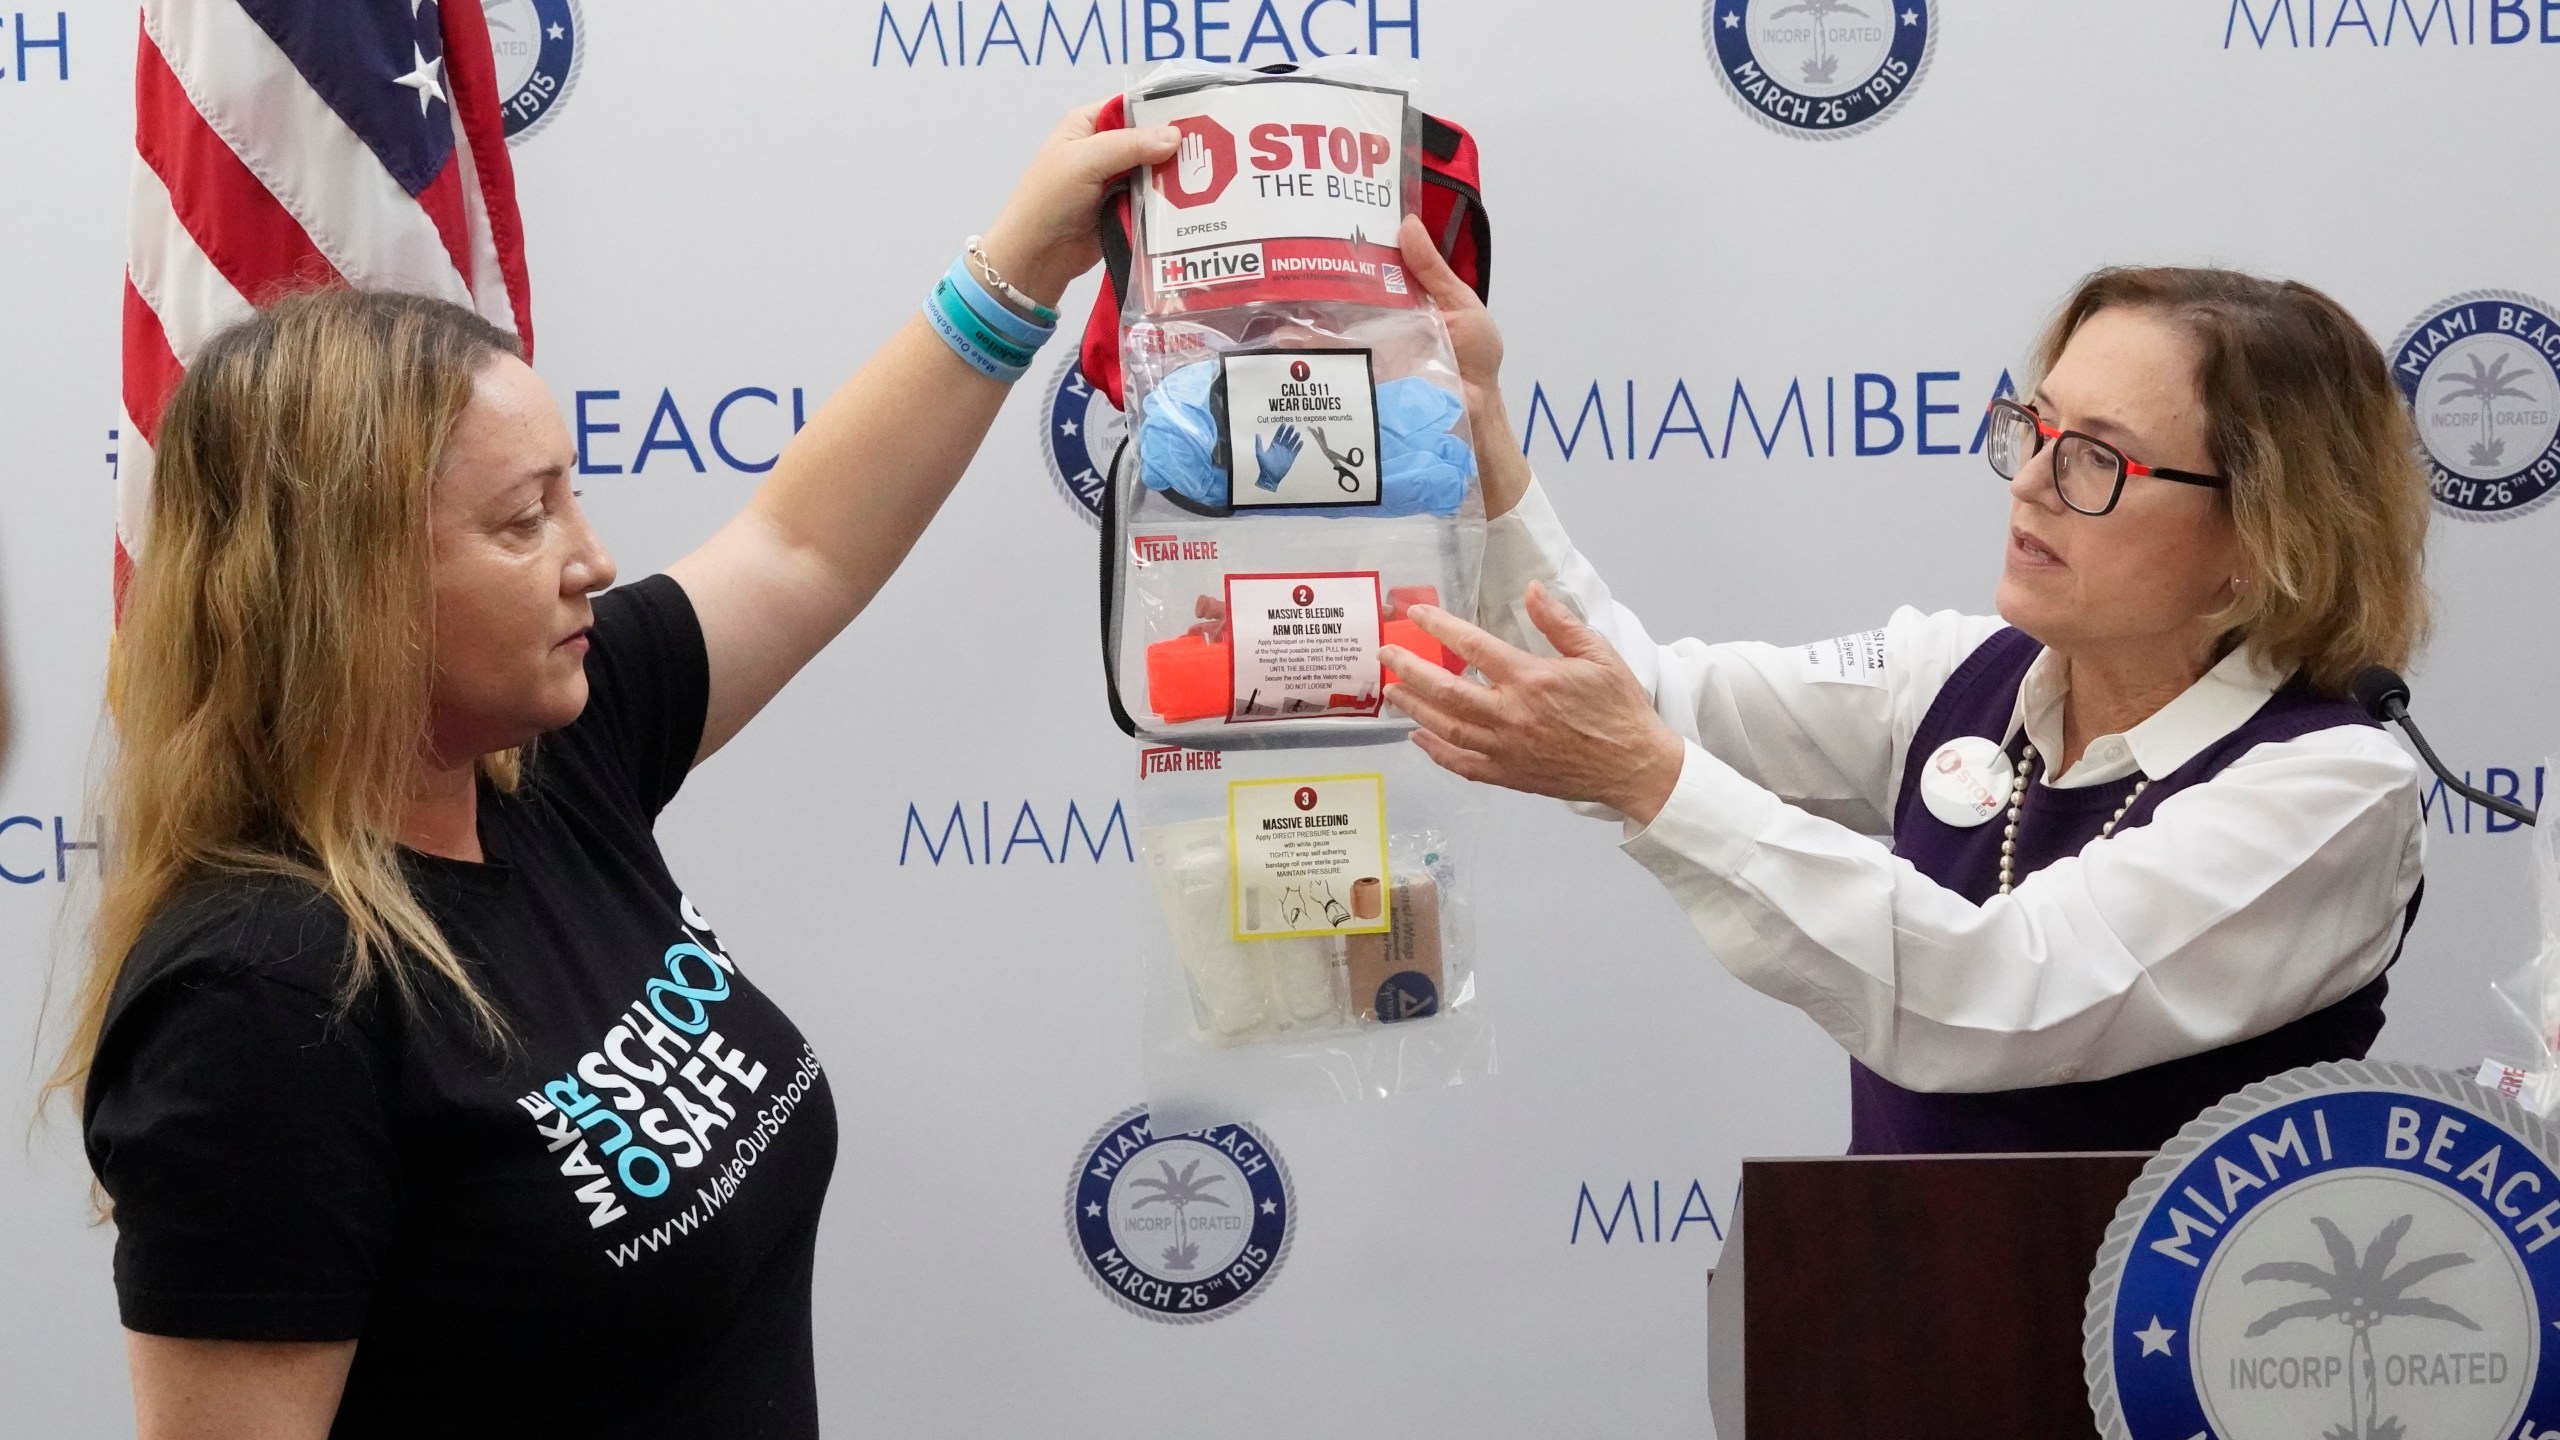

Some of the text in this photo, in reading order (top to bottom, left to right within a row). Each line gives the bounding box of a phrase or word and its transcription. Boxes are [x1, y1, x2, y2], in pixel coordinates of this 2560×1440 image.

[872, 0, 1420, 66] MIAMIBEACH
[1762, 27, 1882, 43] INCORP ORATED
[494, 41, 528, 56] ATED
[511, 70, 556, 121] 1915
[1733, 60, 1811, 124] MARCH
[1863, 56, 1909, 106] 1915
[1249, 123, 1391, 178] STOP
[1252, 174, 1314, 198] THE
[1176, 221, 1228, 237] EXPRESS
[1272, 258, 1377, 275] INDIVIDUAL KIT
[952, 334, 970, 352] Our
[2400, 308, 2477, 376] MIAMI
[1297, 364, 1303, 378] 1
[1281, 383, 1329, 397] CALL 911
[1268, 397, 1342, 412] WEAR GLOVES
[1257, 415, 1269, 424] Cut
[1270, 415, 1294, 423] clothes
[1295, 415, 1302, 423] to
[2431, 410, 2549, 428] INCORP ORATED
[1144, 541, 1219, 561] TEAR HERE
[1299, 589, 1307, 602] 2
[1267, 607, 1345, 620] MASSIVE BLEEDING
[1272, 623, 1342, 636] ARM OR LEG ONLY
[1315, 637, 1333, 645] injured
[1350, 637, 1359, 645] leg
[1289, 647, 1310, 655] possible
[1808, 650, 1820, 665] Hall
[1299, 664, 1327, 672] BLEEDING
[1867, 656, 1876, 669] AM
[1149, 750, 1222, 774] TEAR HERE
[1301, 791, 1310, 806] 3
[1262, 814, 1349, 831] MASSIVE BLEEDING
[899, 797, 1135, 868] MIAM
[1255, 833, 1272, 842] Apply
[1272, 831, 1295, 840] DIRECT
[1296, 829, 1331, 839] PRESSURE
[1338, 828, 1358, 836] wound
[1312, 840, 1331, 848] gauze
[1269, 851, 1295, 859] TIGHTLY
[1295, 851, 1310, 859] wrap
[1276, 867, 1341, 878] MAINTAIN PRESSURE
[639, 1030, 768, 1169] SAFE
[544, 1072, 671, 1198] OUR
[1090, 1118, 1152, 1181] MIAM
[516, 1090, 628, 1230] MAKE
[2150, 1108, 2333, 1268] MIAMI
[1124, 1215, 1242, 1232] INCORP ORATED
[1096, 1247, 1174, 1308] MARCH
[1225, 1243, 1268, 1292] 1915
[2229, 1351, 2509, 1391] INCORP ORATED
